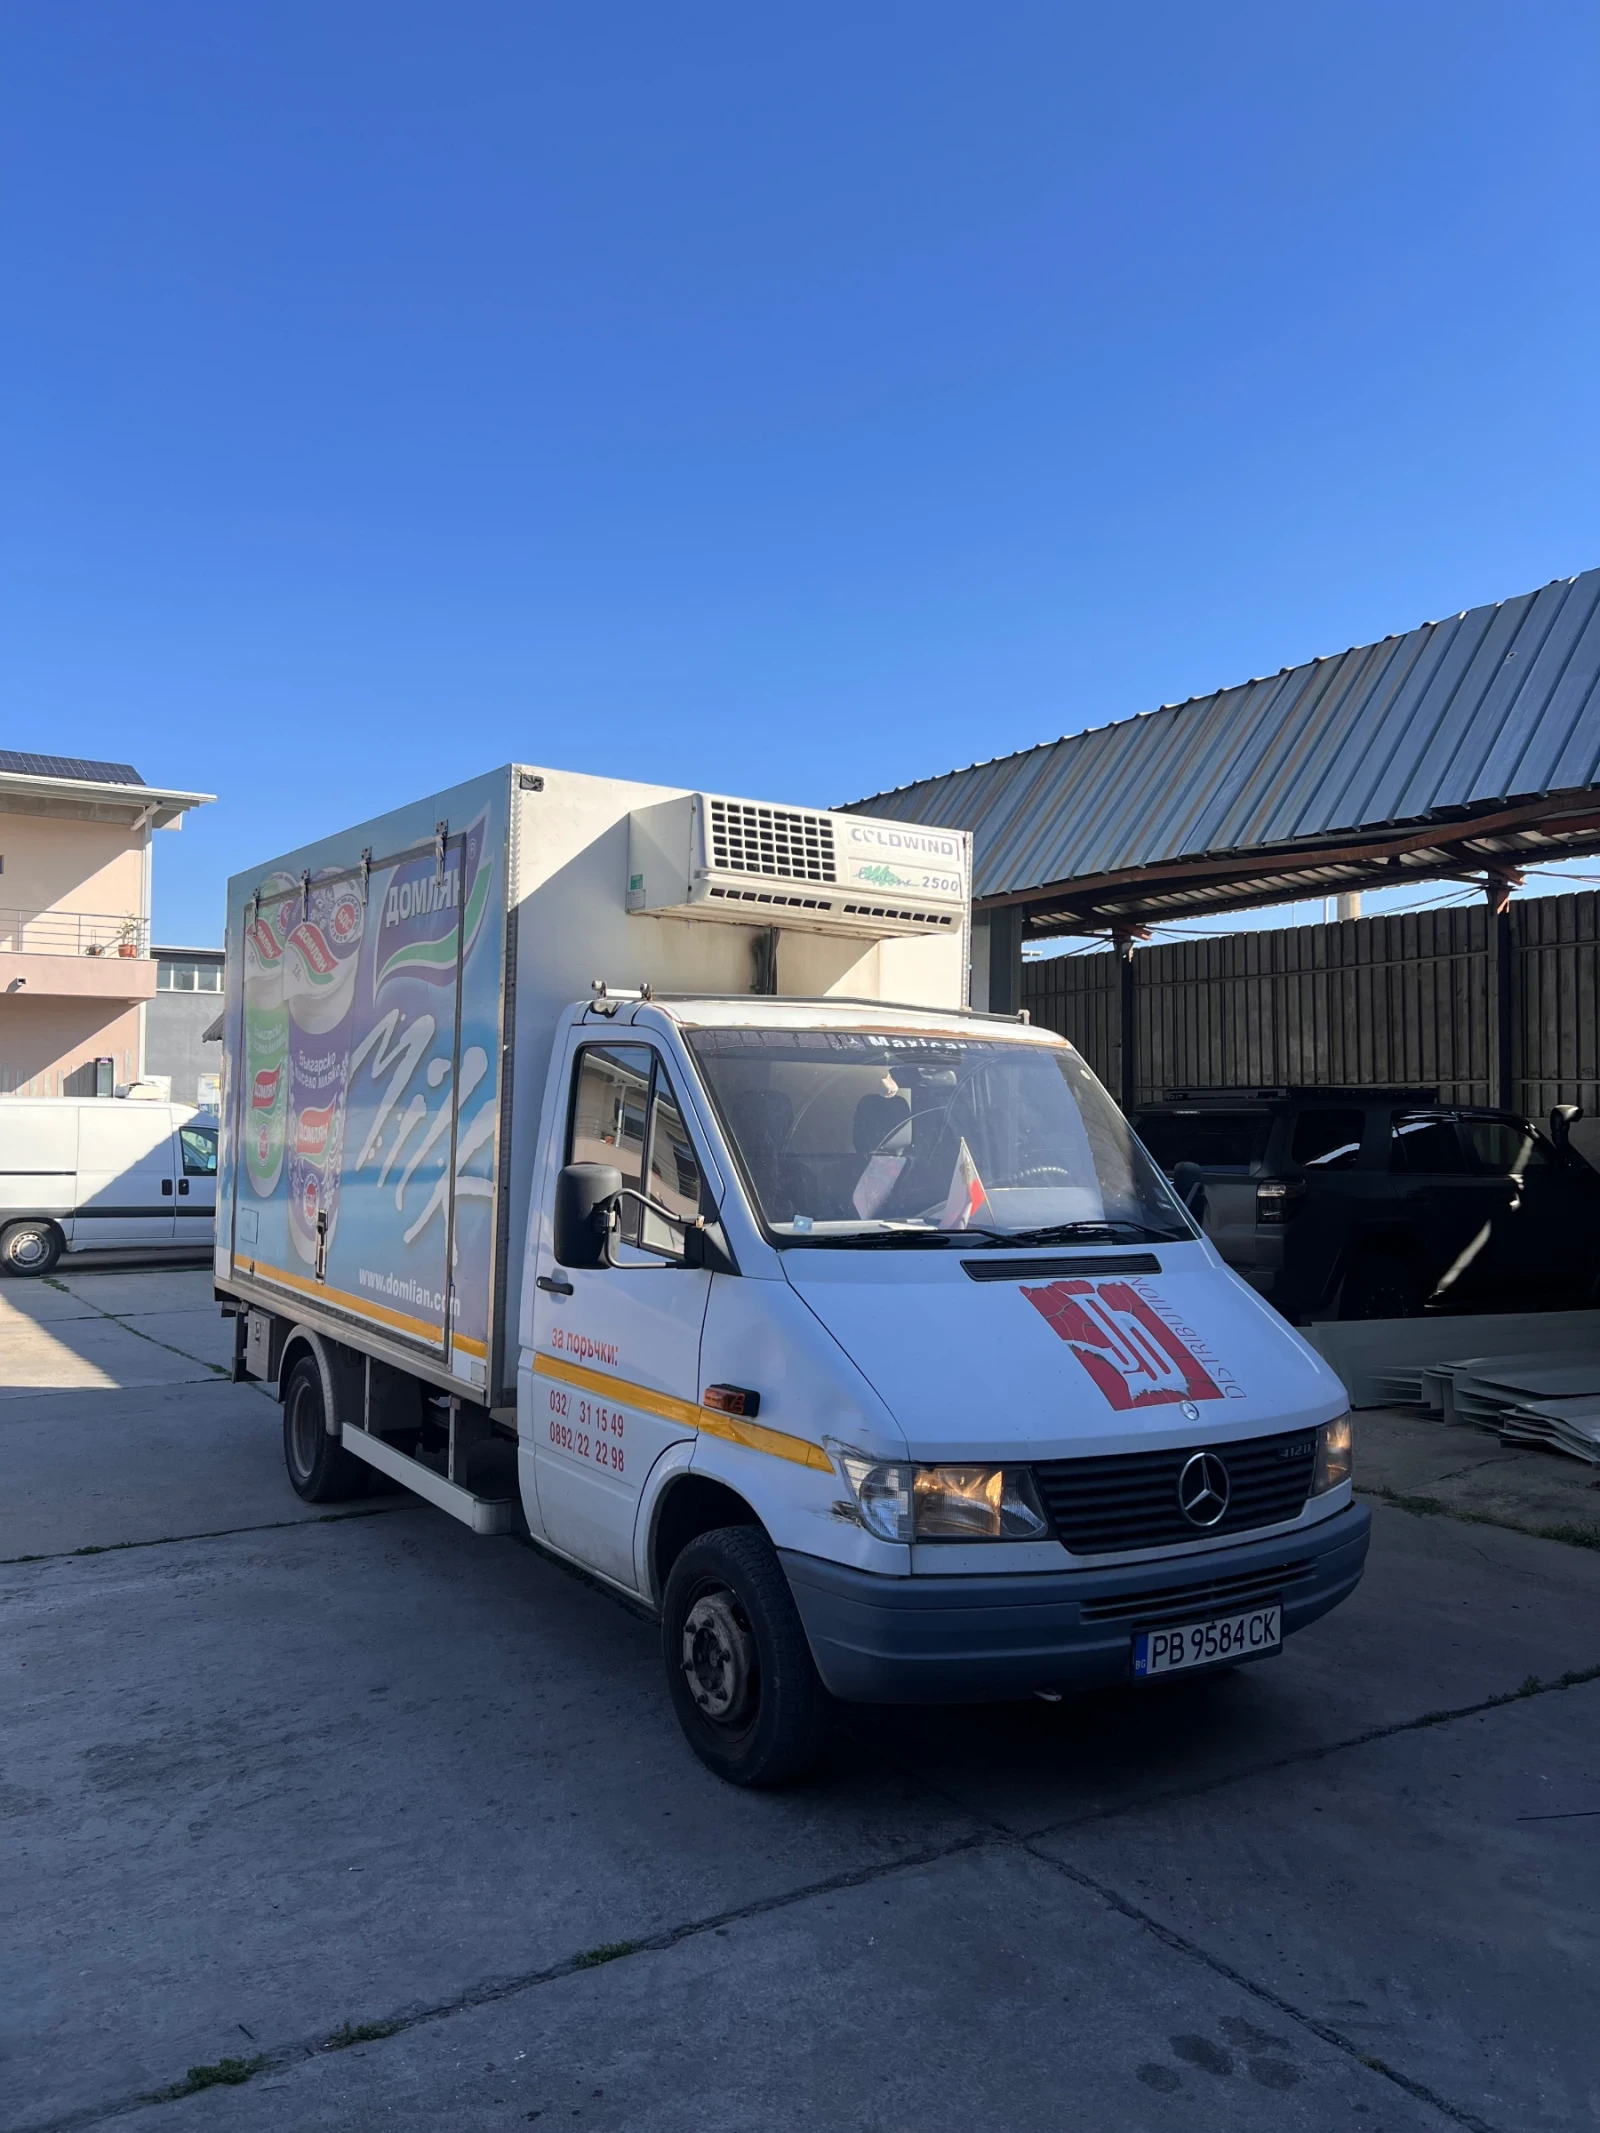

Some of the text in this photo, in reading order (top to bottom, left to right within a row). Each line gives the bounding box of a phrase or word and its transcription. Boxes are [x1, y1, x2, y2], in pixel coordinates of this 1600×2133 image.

[922, 876, 958, 892] 2500
[257, 926, 275, 958] ОМЛЯН
[297, 925, 328, 972] ДОМЛЯН
[551, 1327, 619, 1366] за поръчки:
[1124, 1276, 1247, 1399] DISTRIBUTION
[579, 1400, 591, 1426] 31
[596, 1407, 608, 1432] 15
[610, 1413, 624, 1438] 49
[595, 1440, 608, 1466] 22
[611, 1446, 625, 1472] 98
[1151, 1632, 1185, 1669] PB
[1191, 1619, 1245, 1660] 9584
[1135, 1658, 1147, 1670] BG
